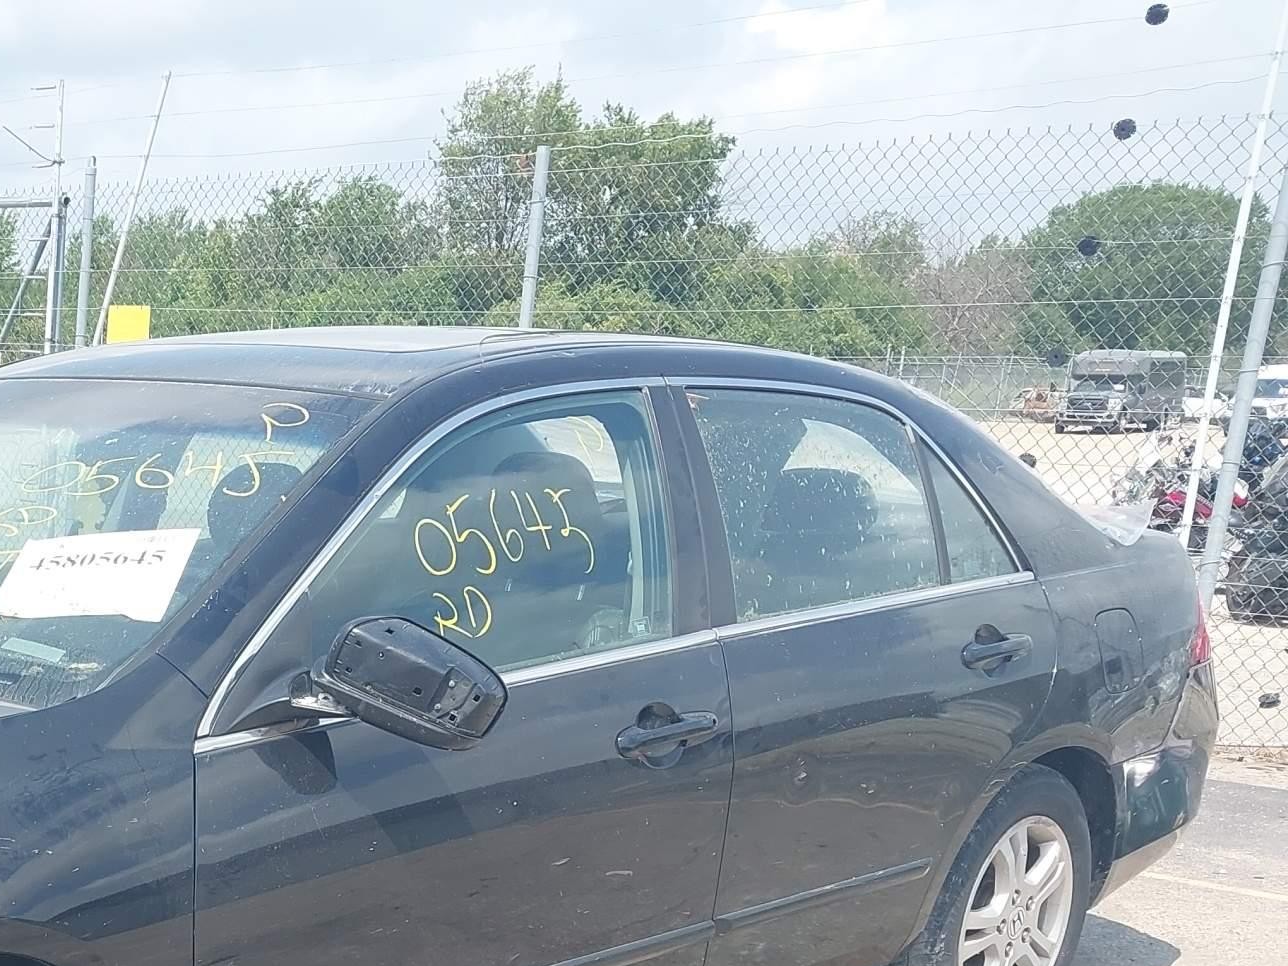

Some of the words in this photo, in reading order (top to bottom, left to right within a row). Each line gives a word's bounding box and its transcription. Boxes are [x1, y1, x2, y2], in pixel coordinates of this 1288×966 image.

[22, 450, 296, 497] 05645
[414, 487, 596, 576] 05645
[29, 549, 168, 571] 45805645
[432, 586, 493, 639] RD
